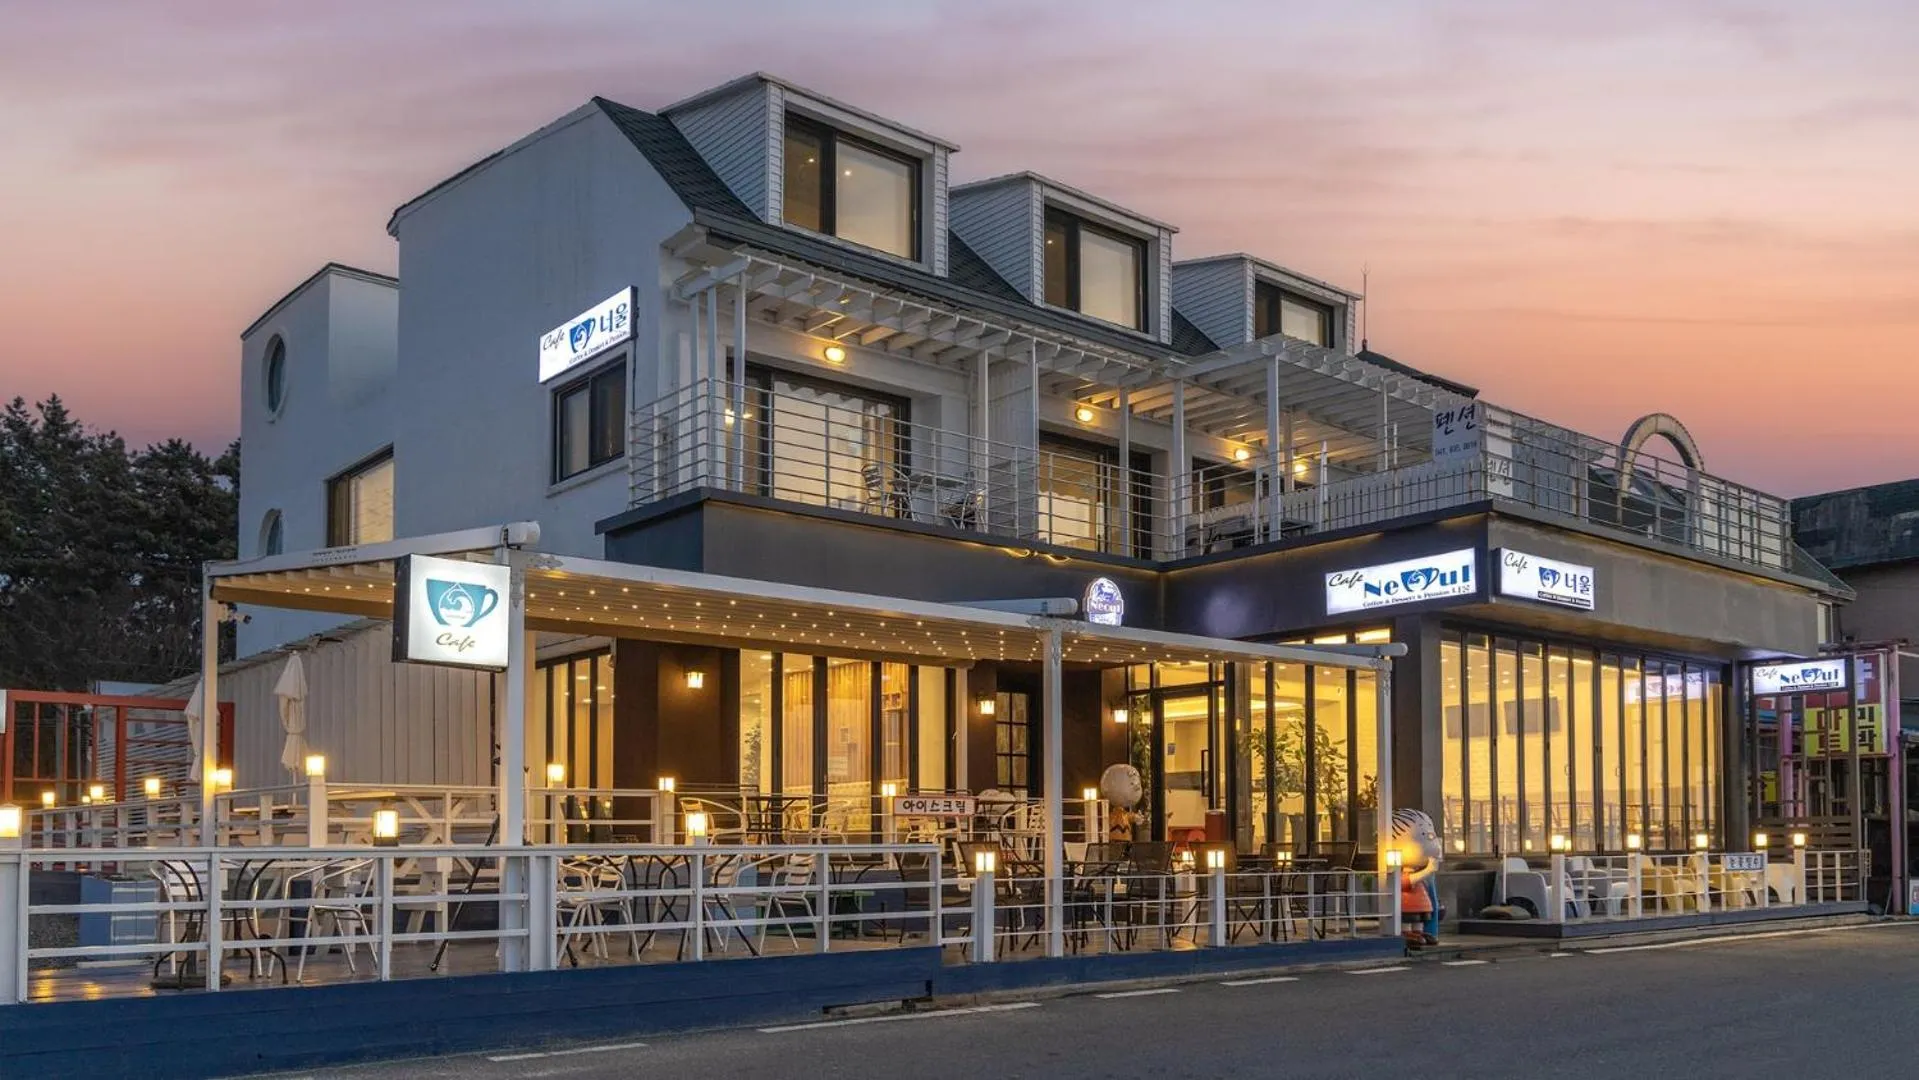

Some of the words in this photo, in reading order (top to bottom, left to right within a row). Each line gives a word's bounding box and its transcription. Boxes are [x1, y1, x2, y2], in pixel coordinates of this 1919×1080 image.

[600, 302, 628, 333] 너울
[1504, 552, 1528, 574] Cafe
[1328, 571, 1364, 589] Cafe
[1565, 573, 1591, 596] 너울
[436, 632, 476, 652] Cafe
[902, 800, 966, 813] 아이스크림
